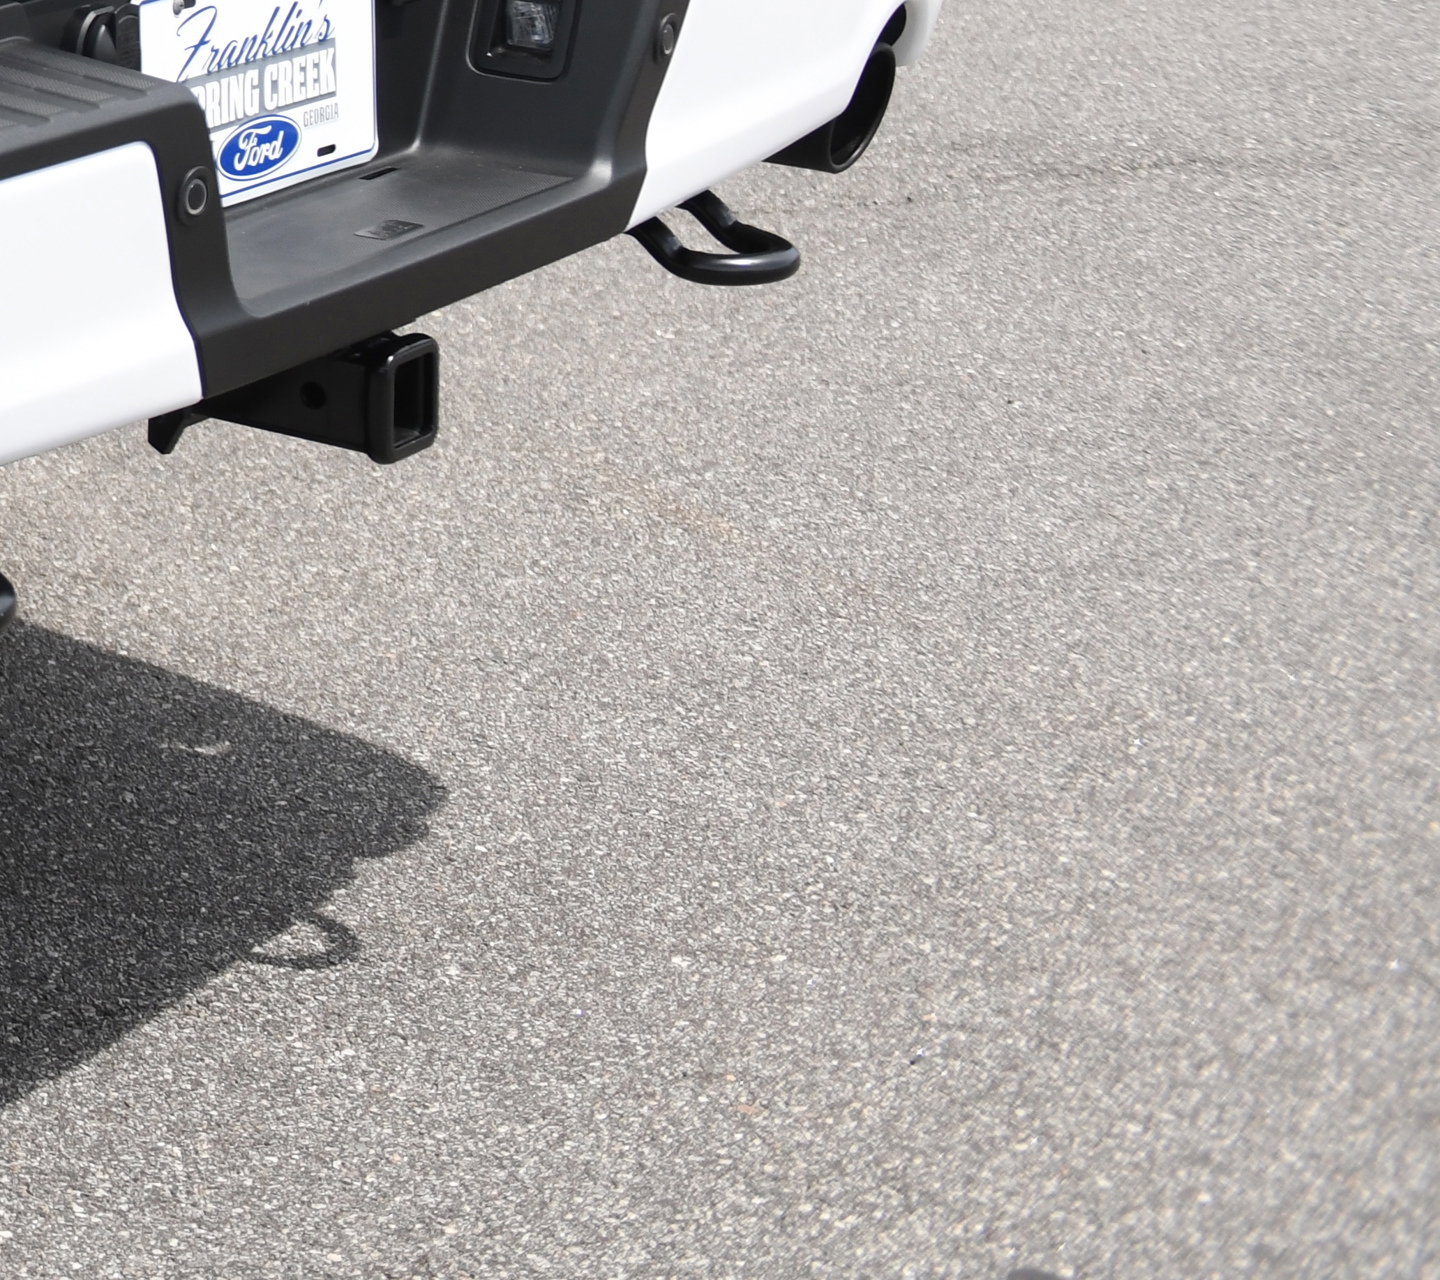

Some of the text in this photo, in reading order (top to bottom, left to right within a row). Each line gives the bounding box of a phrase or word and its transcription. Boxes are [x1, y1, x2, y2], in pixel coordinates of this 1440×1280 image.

[190, 47, 336, 128] RING CREEK
[303, 103, 339, 127] GEORGIA
[233, 125, 284, 171] Ford
